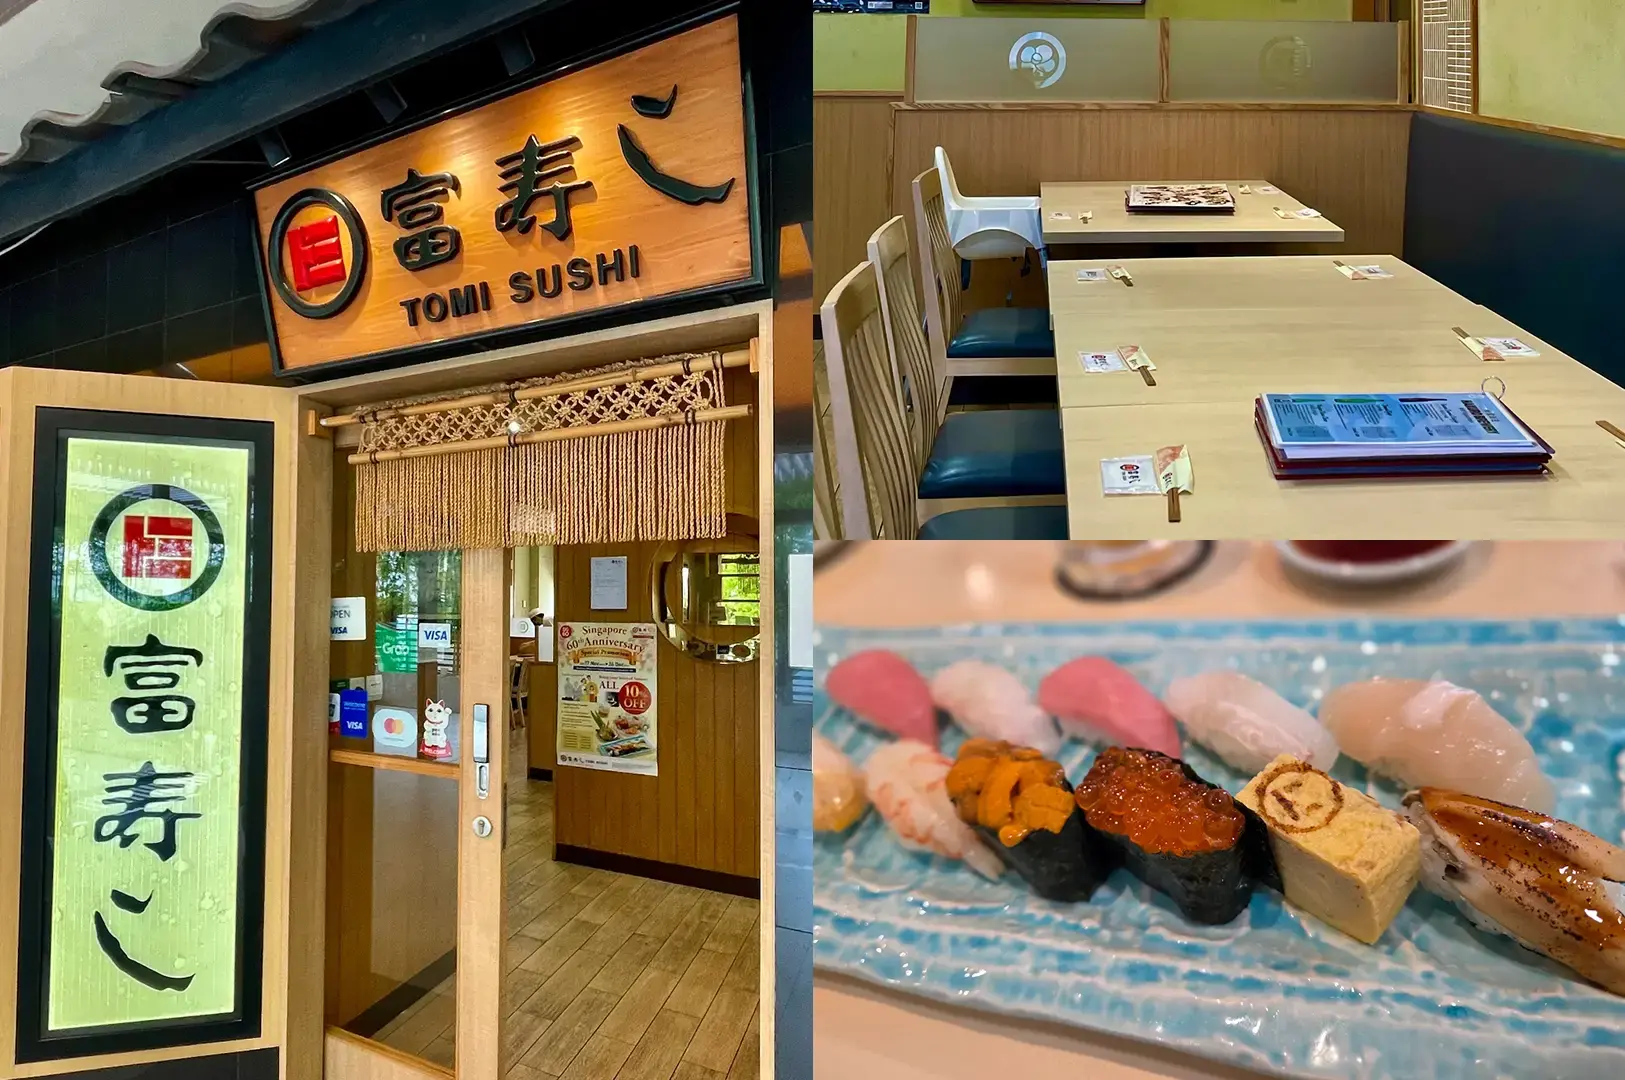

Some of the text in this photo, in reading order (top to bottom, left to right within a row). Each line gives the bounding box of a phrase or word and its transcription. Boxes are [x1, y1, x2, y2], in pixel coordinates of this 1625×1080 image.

[400, 244, 640, 327] TOMI SUSHI
[331, 626, 348, 635] VISA
[424, 630, 448, 641] VISA
[582, 625, 628, 636] Singapore
[382, 642, 410, 656] Grab
[584, 636, 646, 654] Anniversary
[599, 680, 619, 690] ALL
[623, 697, 646, 709] OFF
[346, 720, 363, 730] VISA
